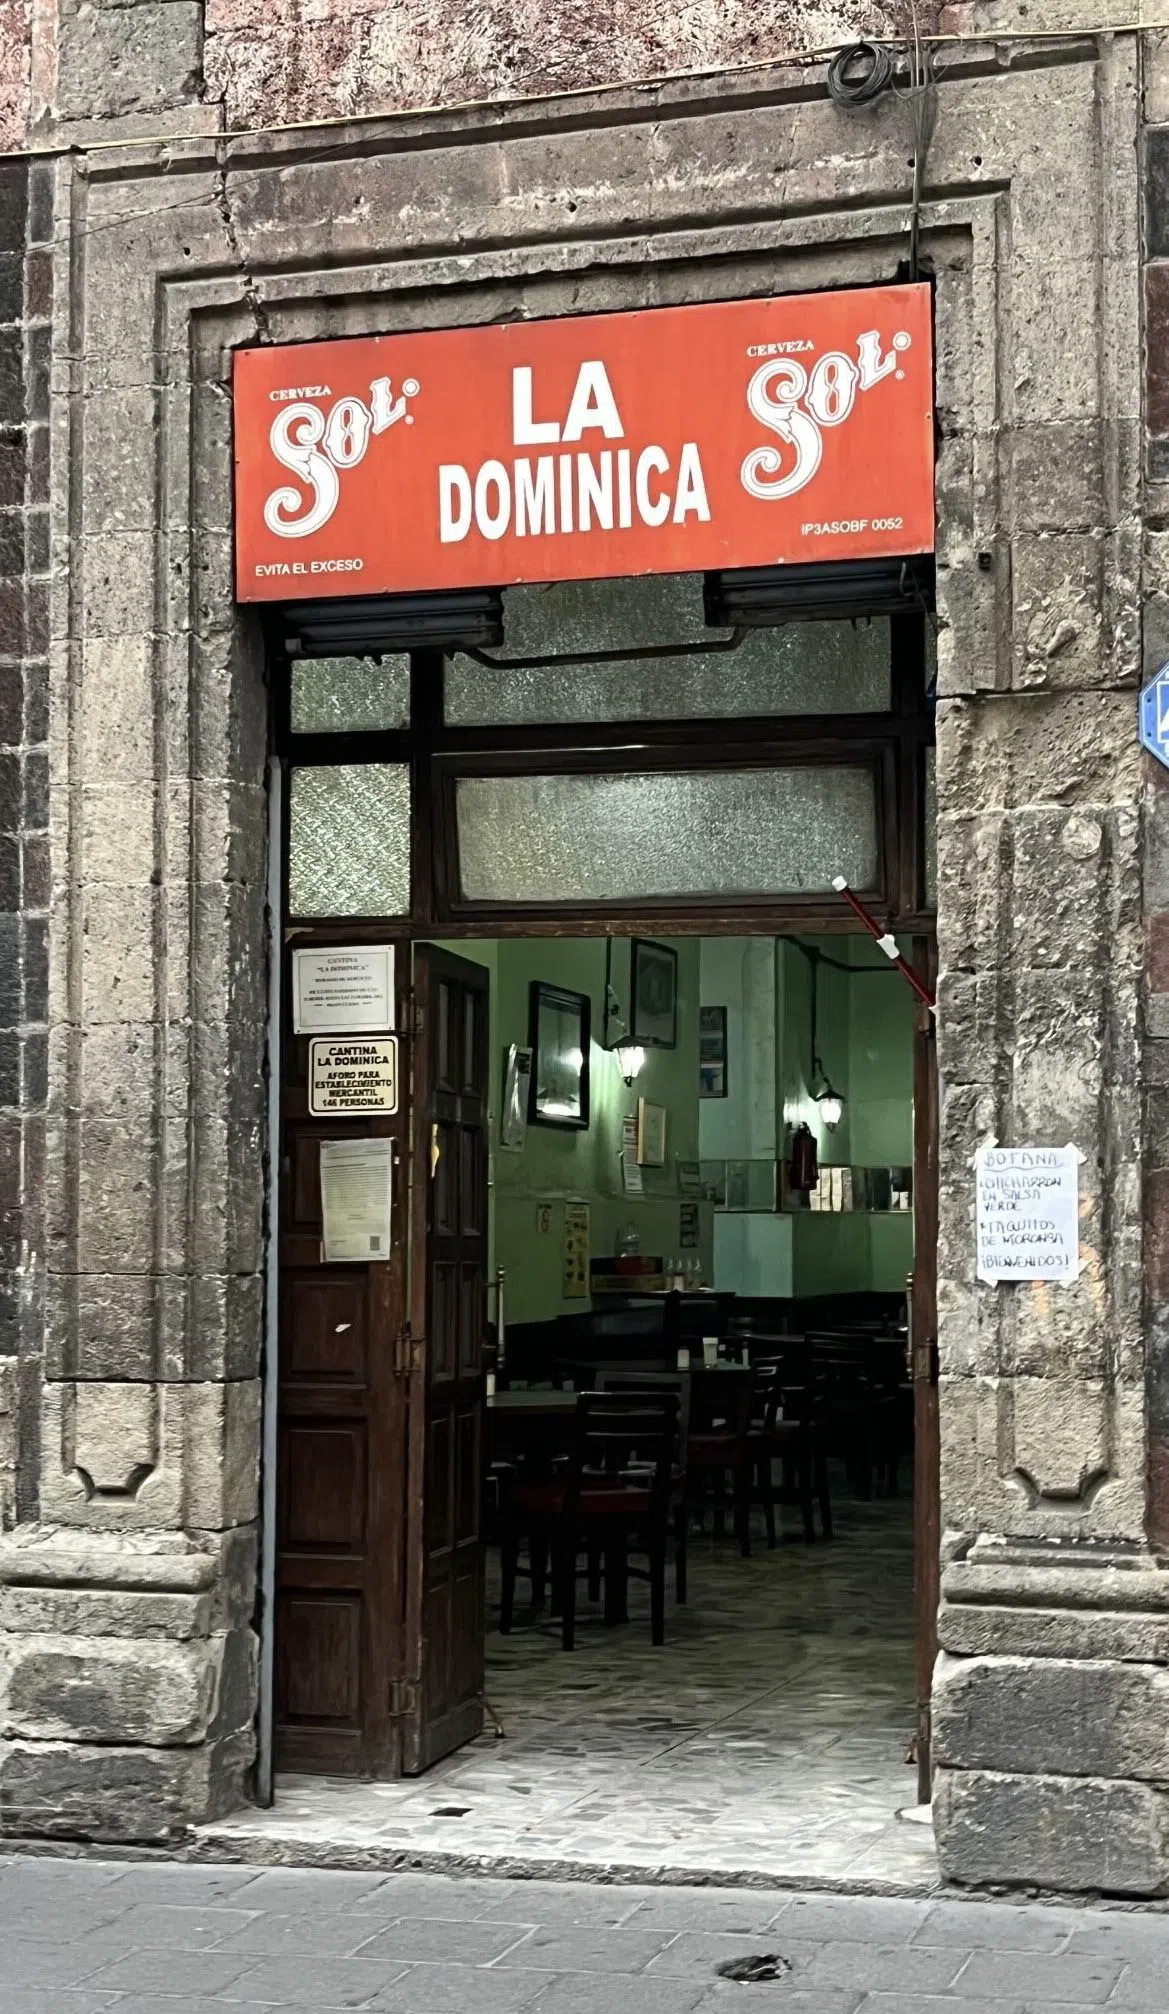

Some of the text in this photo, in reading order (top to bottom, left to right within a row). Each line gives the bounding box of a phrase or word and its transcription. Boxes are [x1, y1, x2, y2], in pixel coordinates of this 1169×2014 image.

[746, 340, 814, 357] CERVEZA
[269, 385, 332, 401] CERVEZA
[512, 360, 625, 446] LA
[740, 329, 898, 500] SOL
[264, 376, 407, 538] SOL
[438, 441, 712, 544] DOMINICA
[801, 516, 904, 536] IP3ASOBF 0052
[255, 558, 364, 577] EVITA EL EXCESO
[329, 1046, 378, 1056] CANTINA
[317, 1055, 390, 1067] LA DOMINICA
[327, 1070, 380, 1080] AFORO PARA
[315, 1079, 392, 1089] ESTABLECIMIENTO
[328, 1088, 378, 1097] MERCANTIL
[339, 1097, 385, 1107] PERSONAS
[984, 1152, 1058, 1167] BOTANA
[982, 1189, 1041, 1201] EN SALSA
[984, 1201, 1022, 1212] VERDE
[981, 1235, 997, 1246] DE
